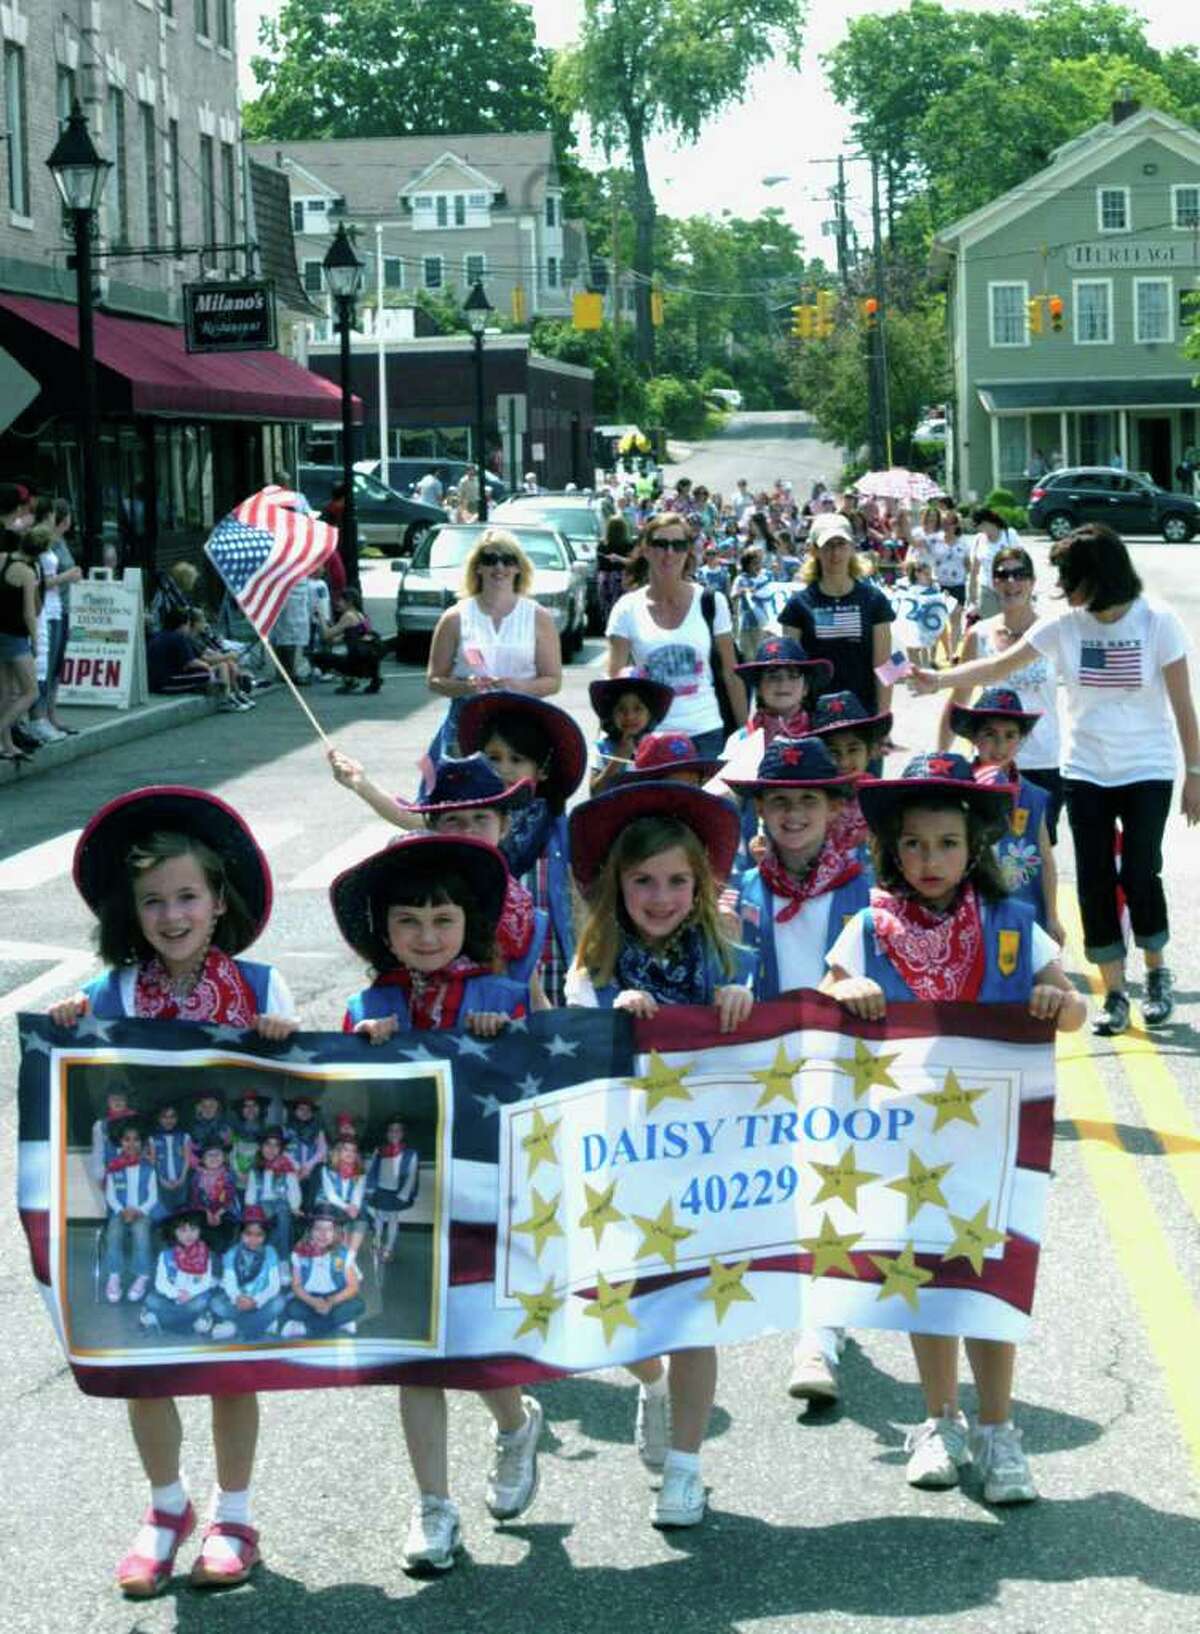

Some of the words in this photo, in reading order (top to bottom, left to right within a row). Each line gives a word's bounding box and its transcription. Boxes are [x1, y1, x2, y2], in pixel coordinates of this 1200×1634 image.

[195, 292, 265, 312] Milano's
[59, 658, 121, 688] OPEN
[582, 1117, 726, 1173] DAISY
[735, 1105, 915, 1149] TROOP
[680, 1164, 798, 1216] 40229
